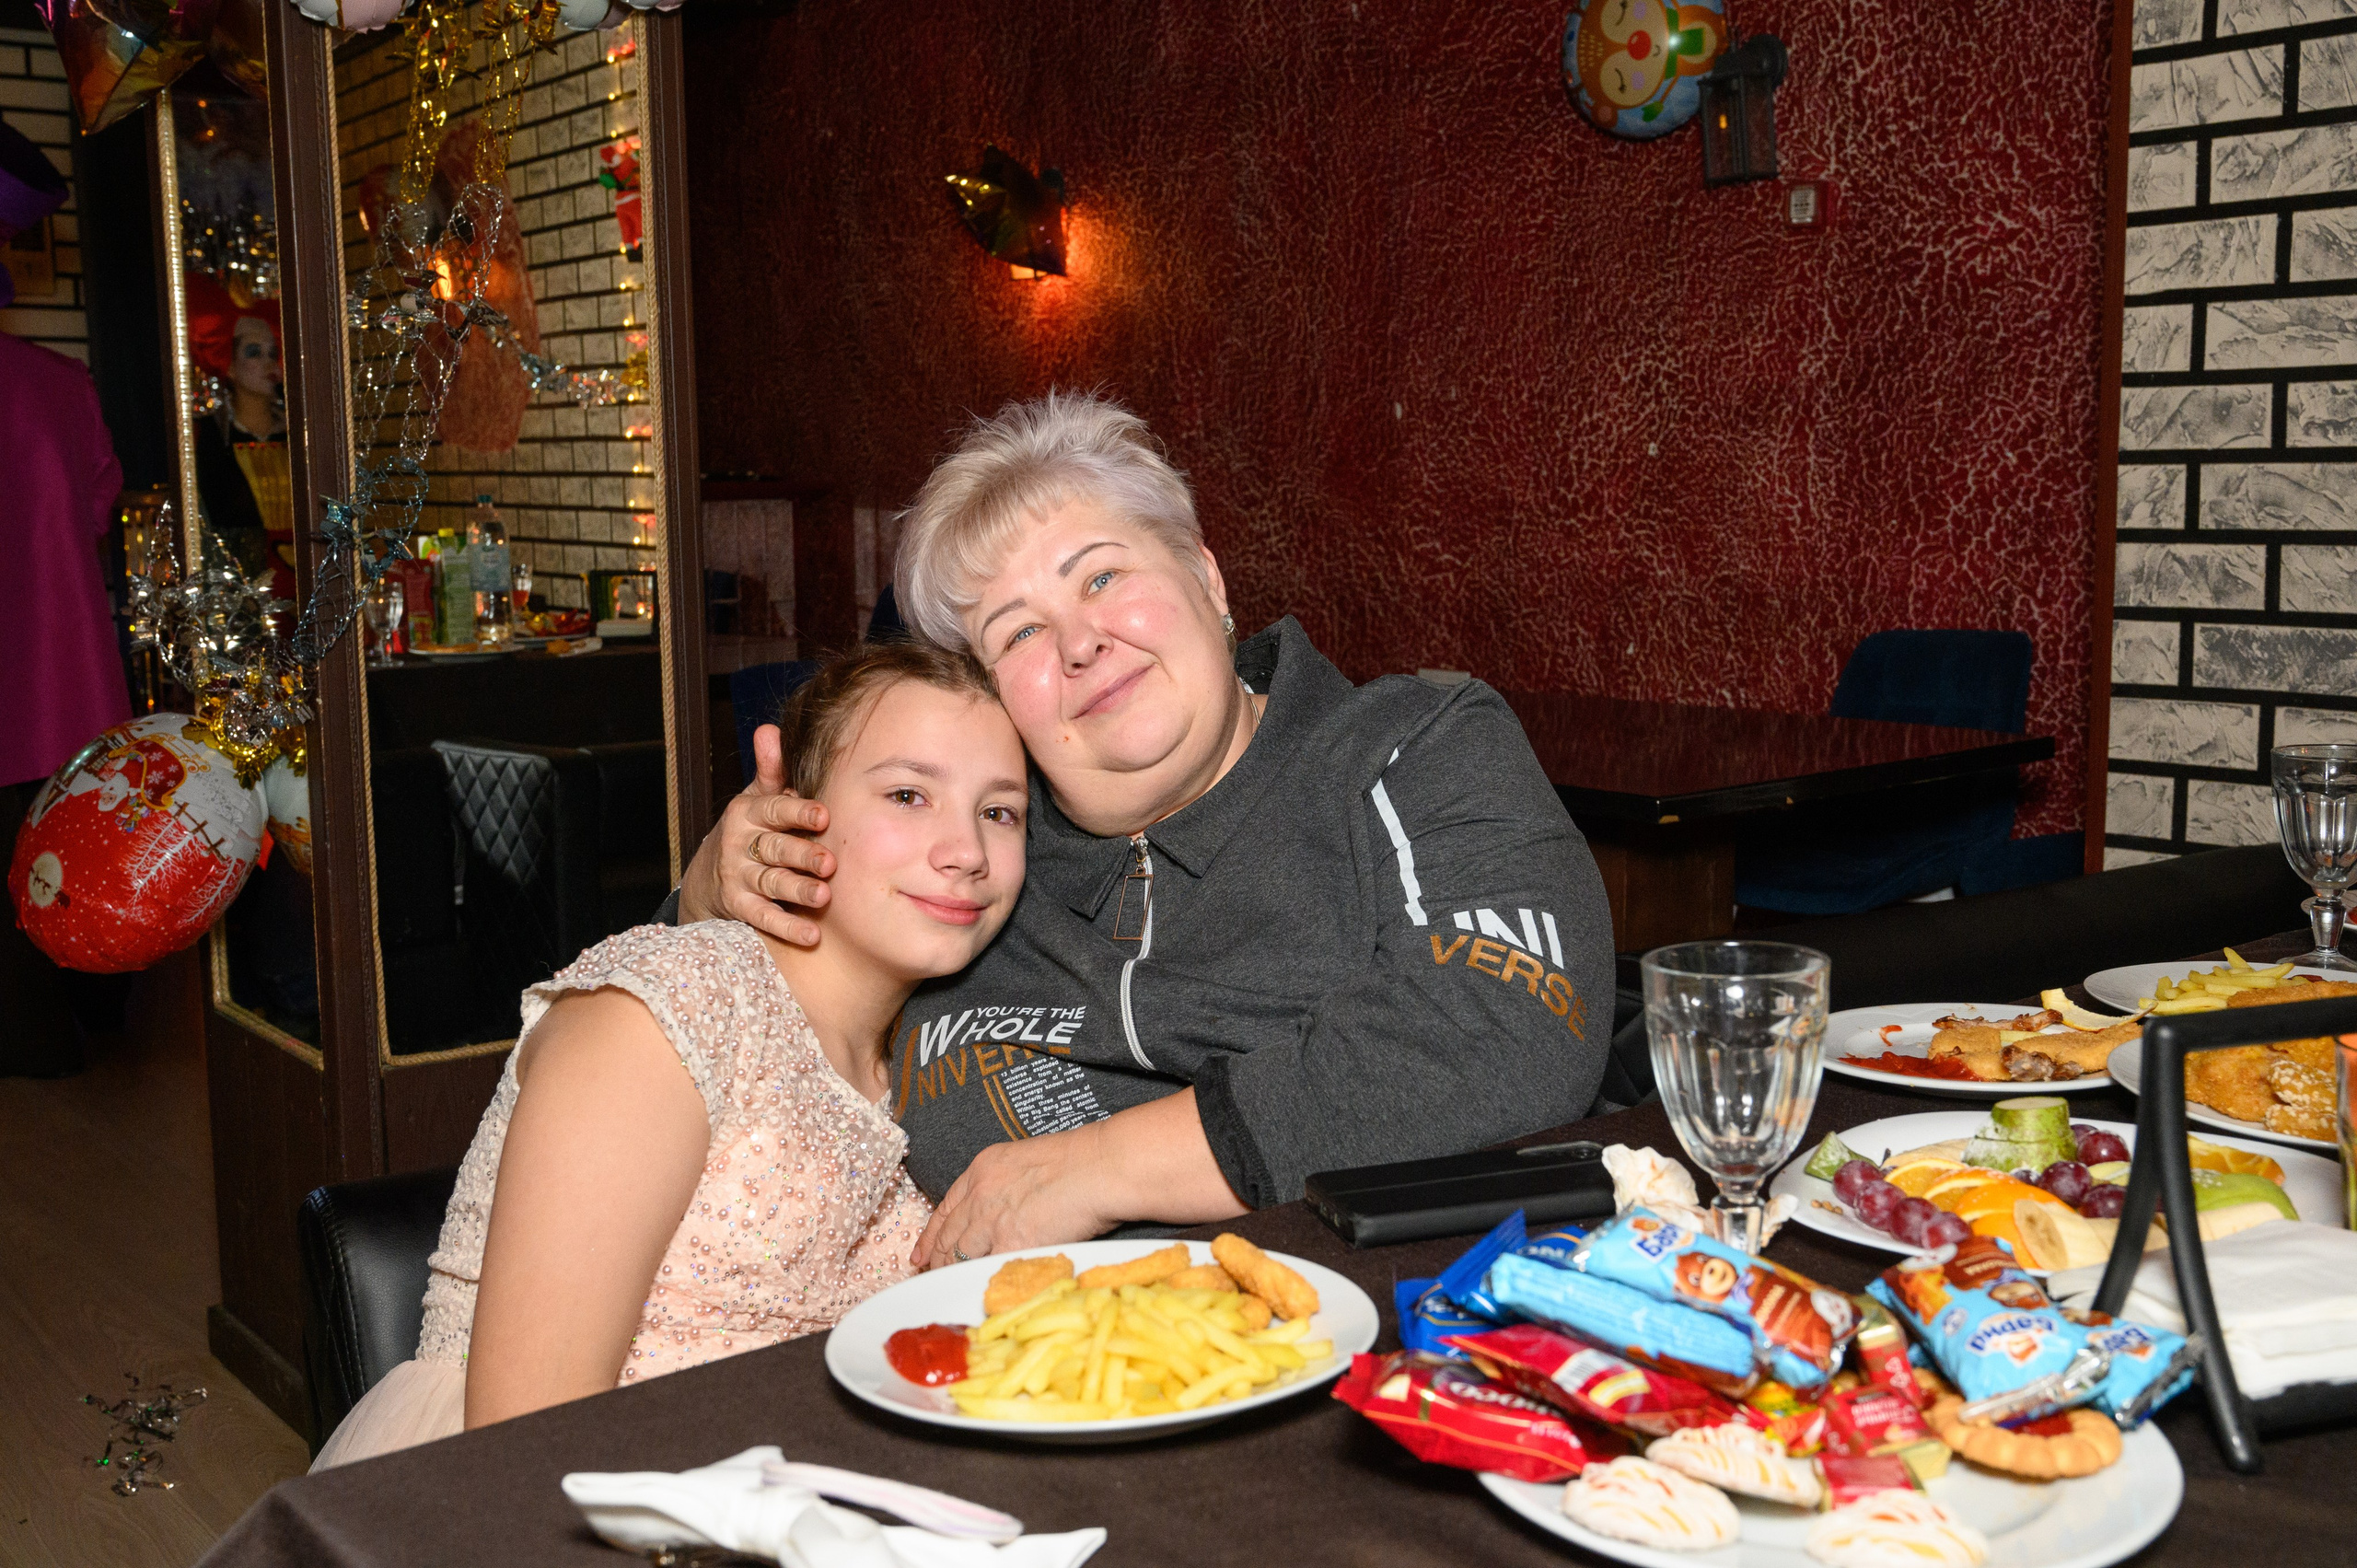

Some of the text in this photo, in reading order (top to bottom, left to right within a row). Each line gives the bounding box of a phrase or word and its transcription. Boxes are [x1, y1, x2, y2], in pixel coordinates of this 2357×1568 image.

[1430, 935, 1587, 1041] VERSE
[977, 1005, 1086, 1020] YOU'RE THE
[921, 1009, 1083, 1067] WHOLE
[1004, 1060, 1059, 1084] universe exploded
[1010, 1064, 1028, 1074] billion
[1031, 1058, 1047, 1067] years
[1005, 1076, 1032, 1090] existence
[1038, 1070, 1052, 1078] from
[1008, 1078, 1048, 1096] concentration
[1063, 1066, 1082, 1076] matter
[1011, 1094, 1022, 1102] and
[1024, 1087, 1043, 1098] energy
[1044, 1080, 1064, 1090] known
[1016, 1104, 1036, 1113] Within
[1039, 1098, 1053, 1106] three
[1057, 1088, 1080, 1099] minutes
[1014, 1094, 1045, 1109] singularity.
[1042, 1103, 1059, 1112] Bang
[1072, 1091, 1093, 1102] centers
[1055, 1104, 1074, 1114] called
[1076, 1097, 1097, 1108] atomic
[1085, 1103, 1099, 1111] from
[1031, 1119, 1060, 1136] subatomic
[1070, 1114, 1086, 1124] years
